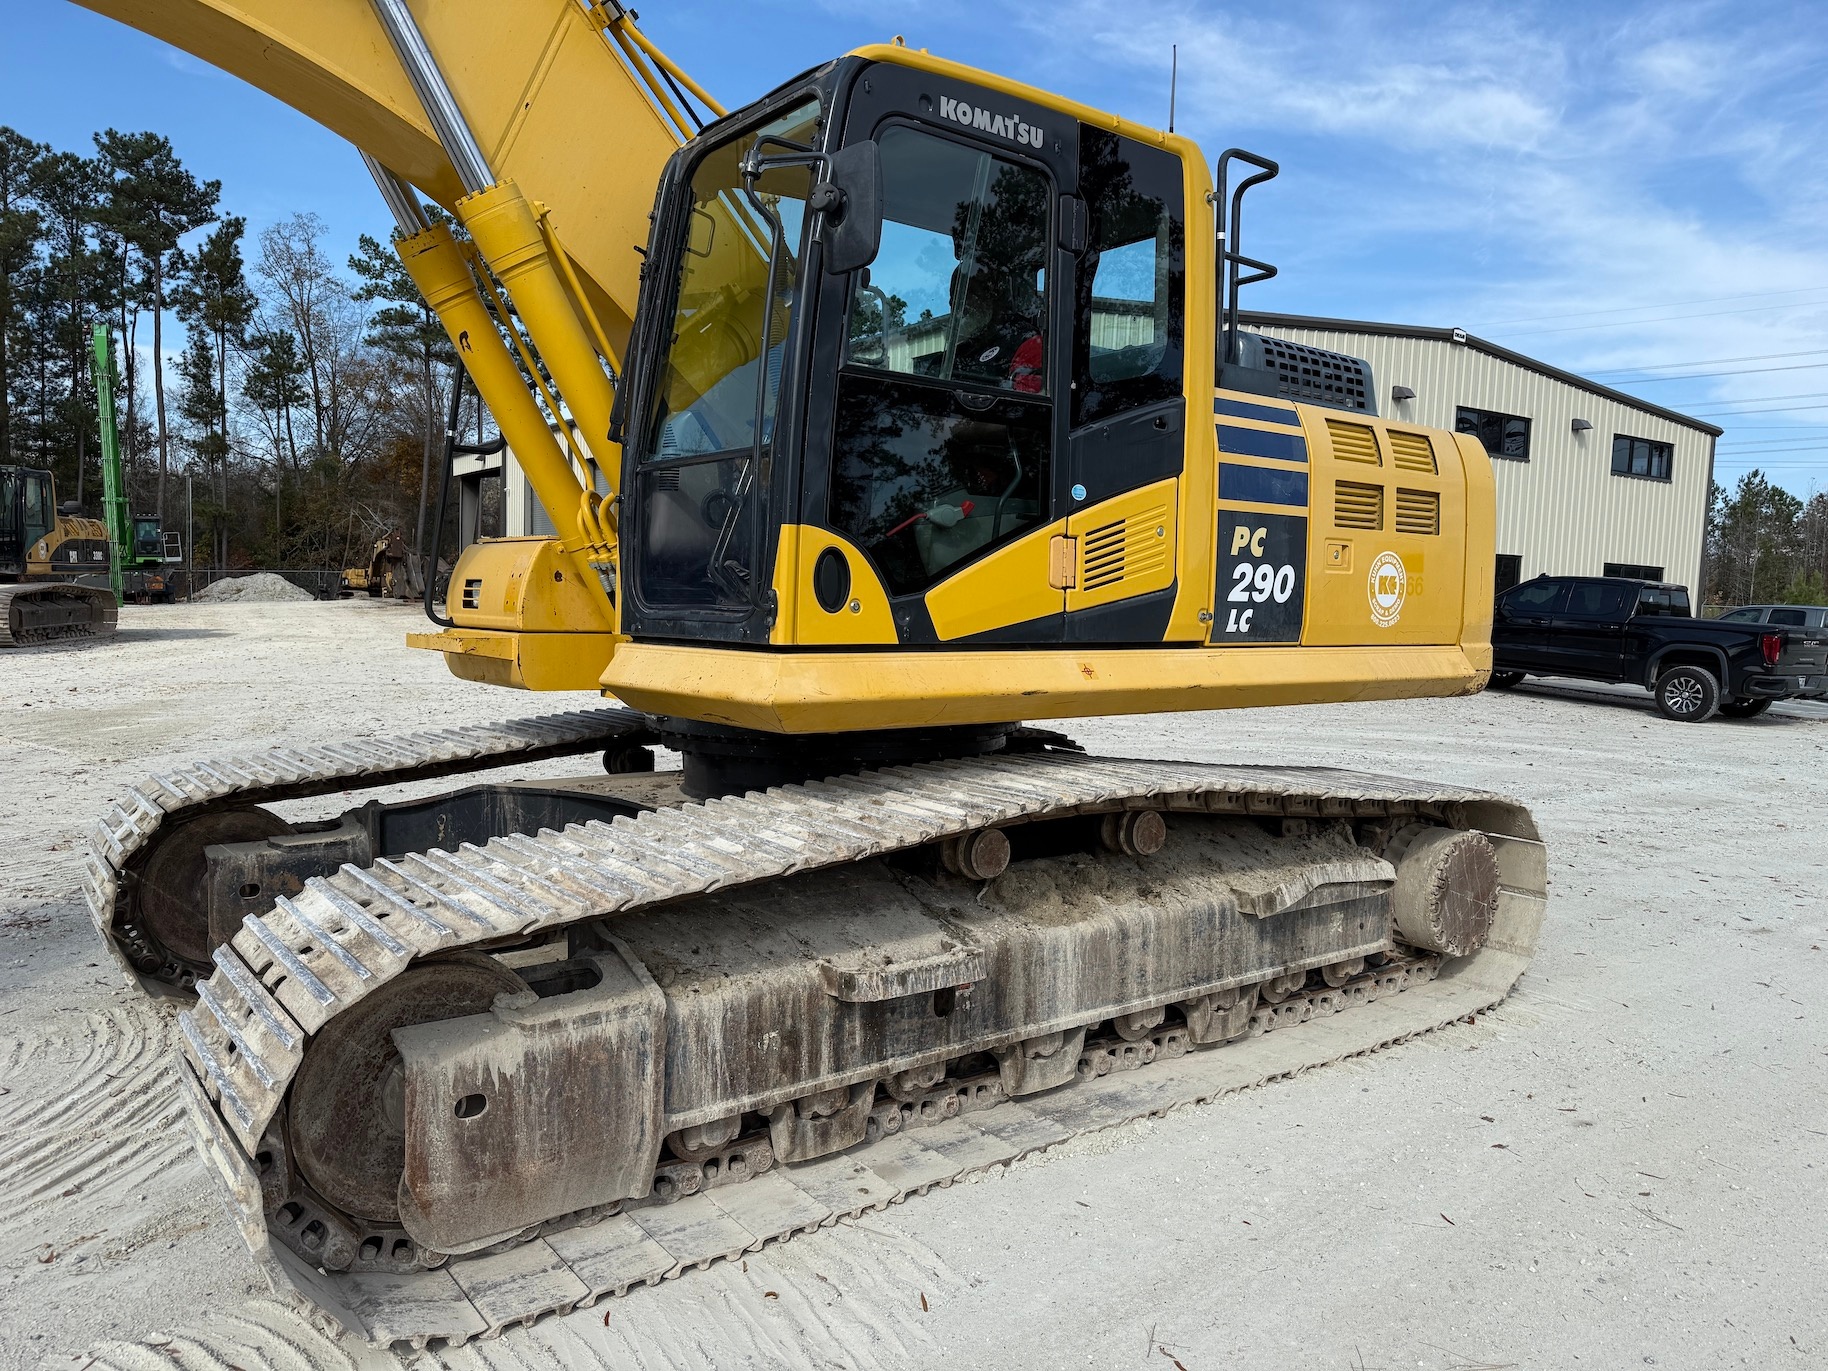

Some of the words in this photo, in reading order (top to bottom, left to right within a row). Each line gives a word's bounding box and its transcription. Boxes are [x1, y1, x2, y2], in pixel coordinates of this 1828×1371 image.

[940, 96, 1044, 149] KOMATSU
[1230, 525, 1267, 558] PC
[1227, 562, 1296, 603] 290
[1225, 608, 1254, 633] LC
